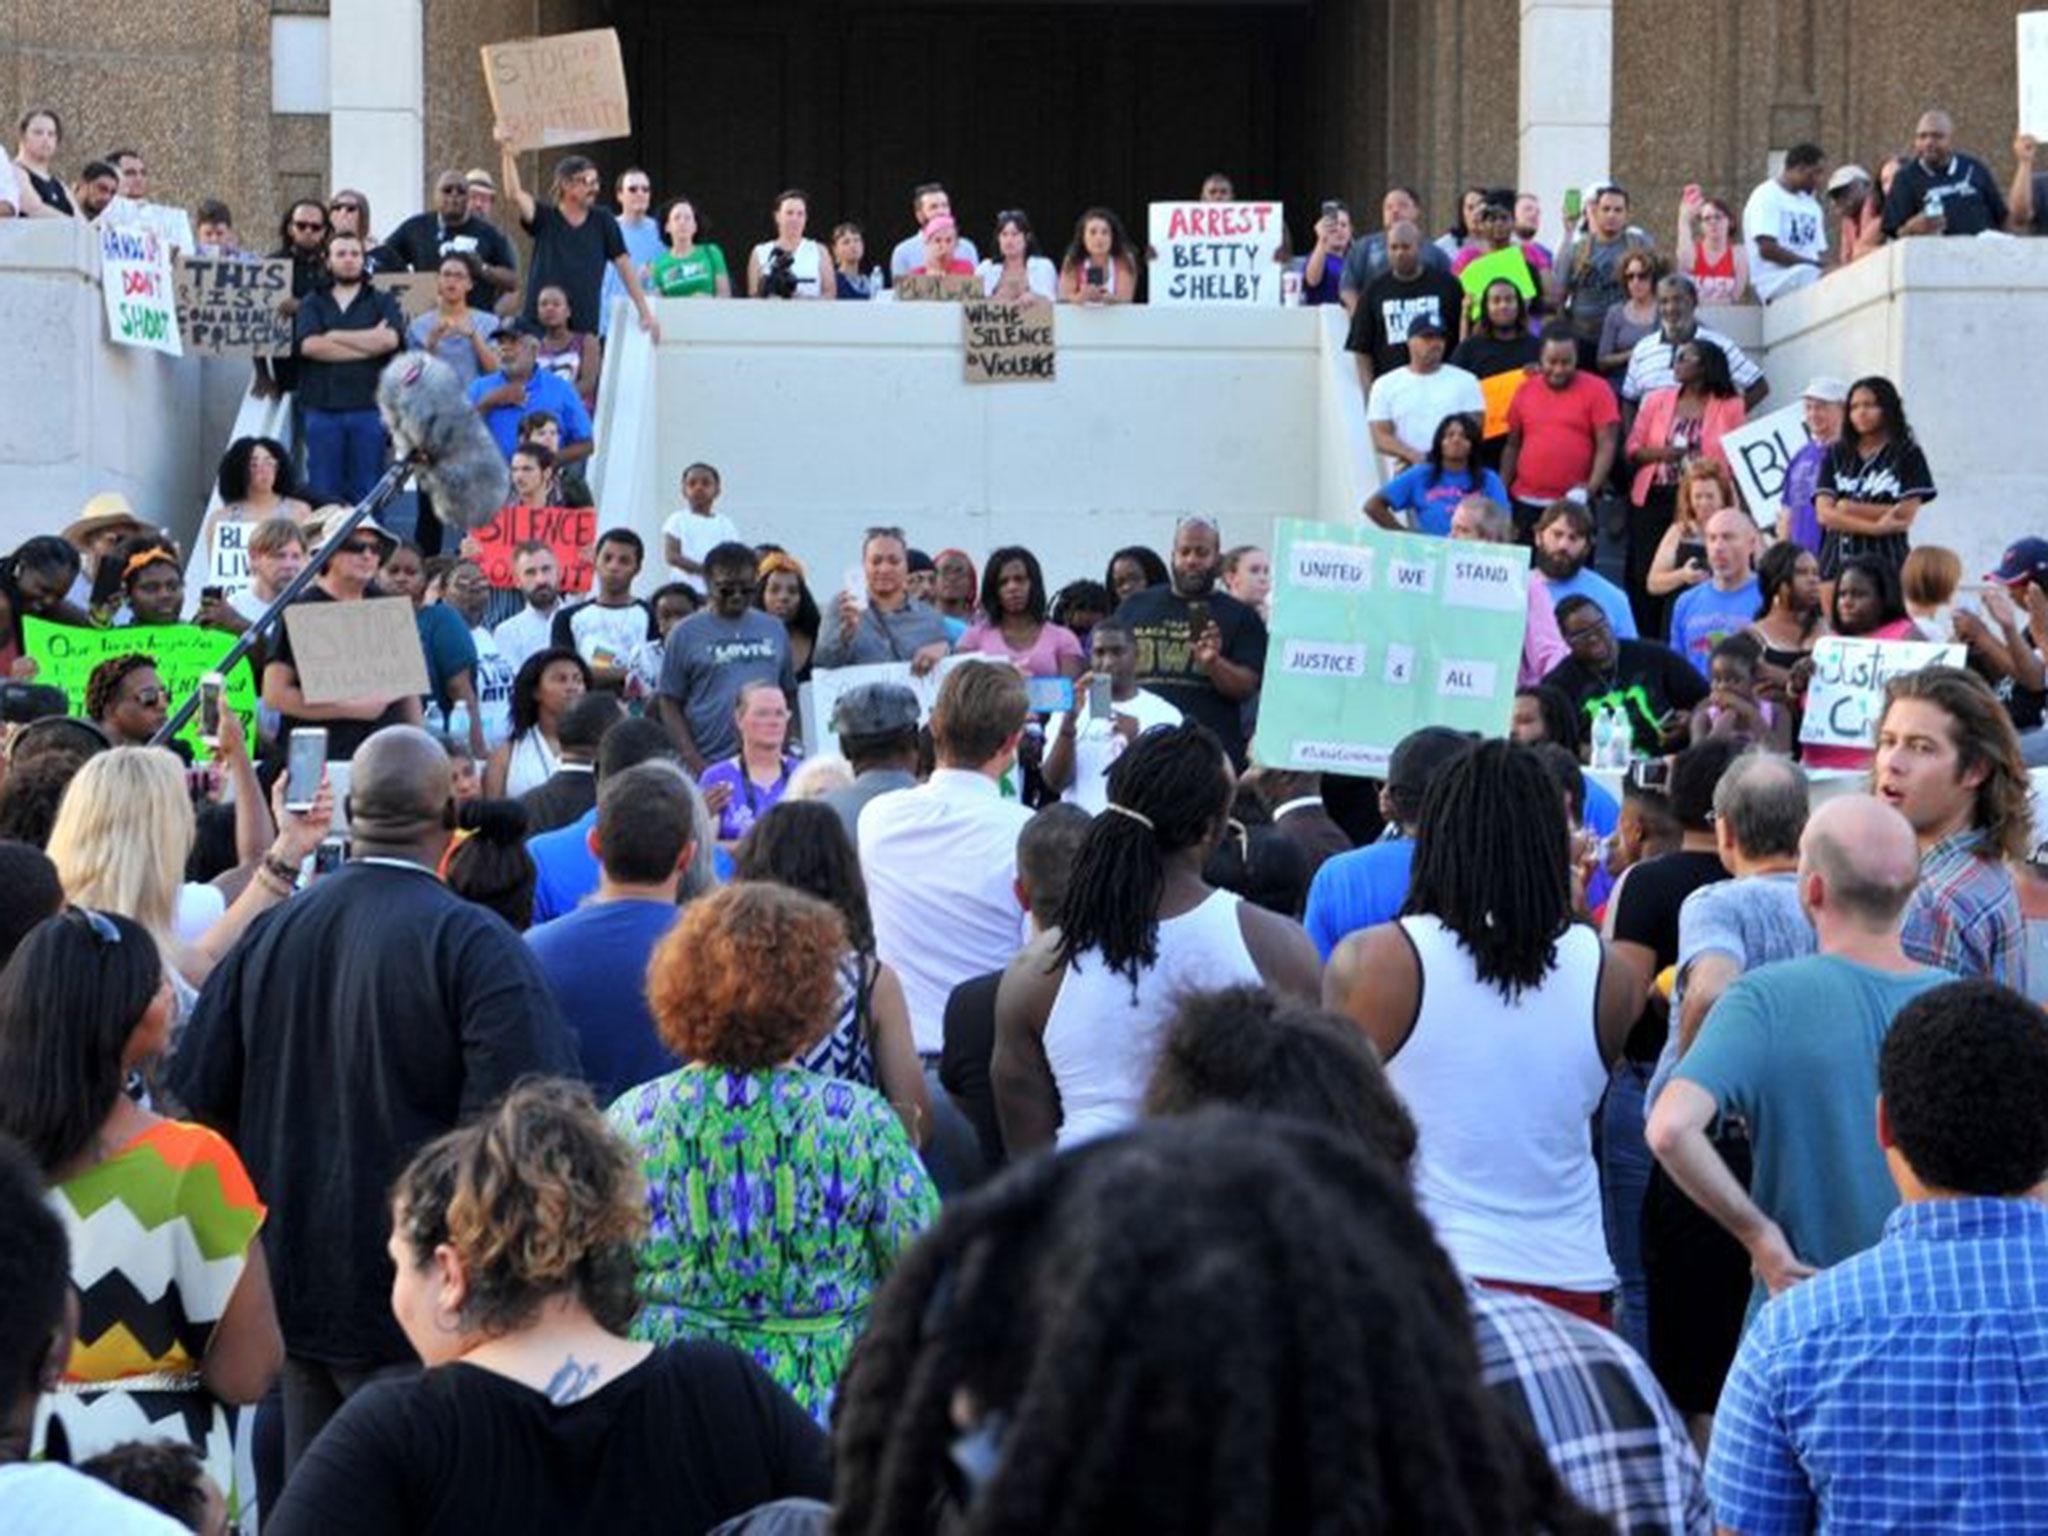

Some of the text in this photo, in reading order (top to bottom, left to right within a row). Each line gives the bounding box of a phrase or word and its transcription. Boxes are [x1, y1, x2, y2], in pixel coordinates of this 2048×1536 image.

[493, 40, 579, 85] STOP
[1168, 204, 1273, 239] ARREST
[1172, 243, 1259, 270] BETTY
[185, 261, 285, 290] THIS
[1168, 273, 1261, 302] SHELBY
[120, 302, 169, 341] SHOOT
[970, 327, 1053, 348] SILENCE
[1300, 560, 1509, 586] UNITED WE STAND
[1291, 652, 1473, 688] JUSTICE 4 ALL
